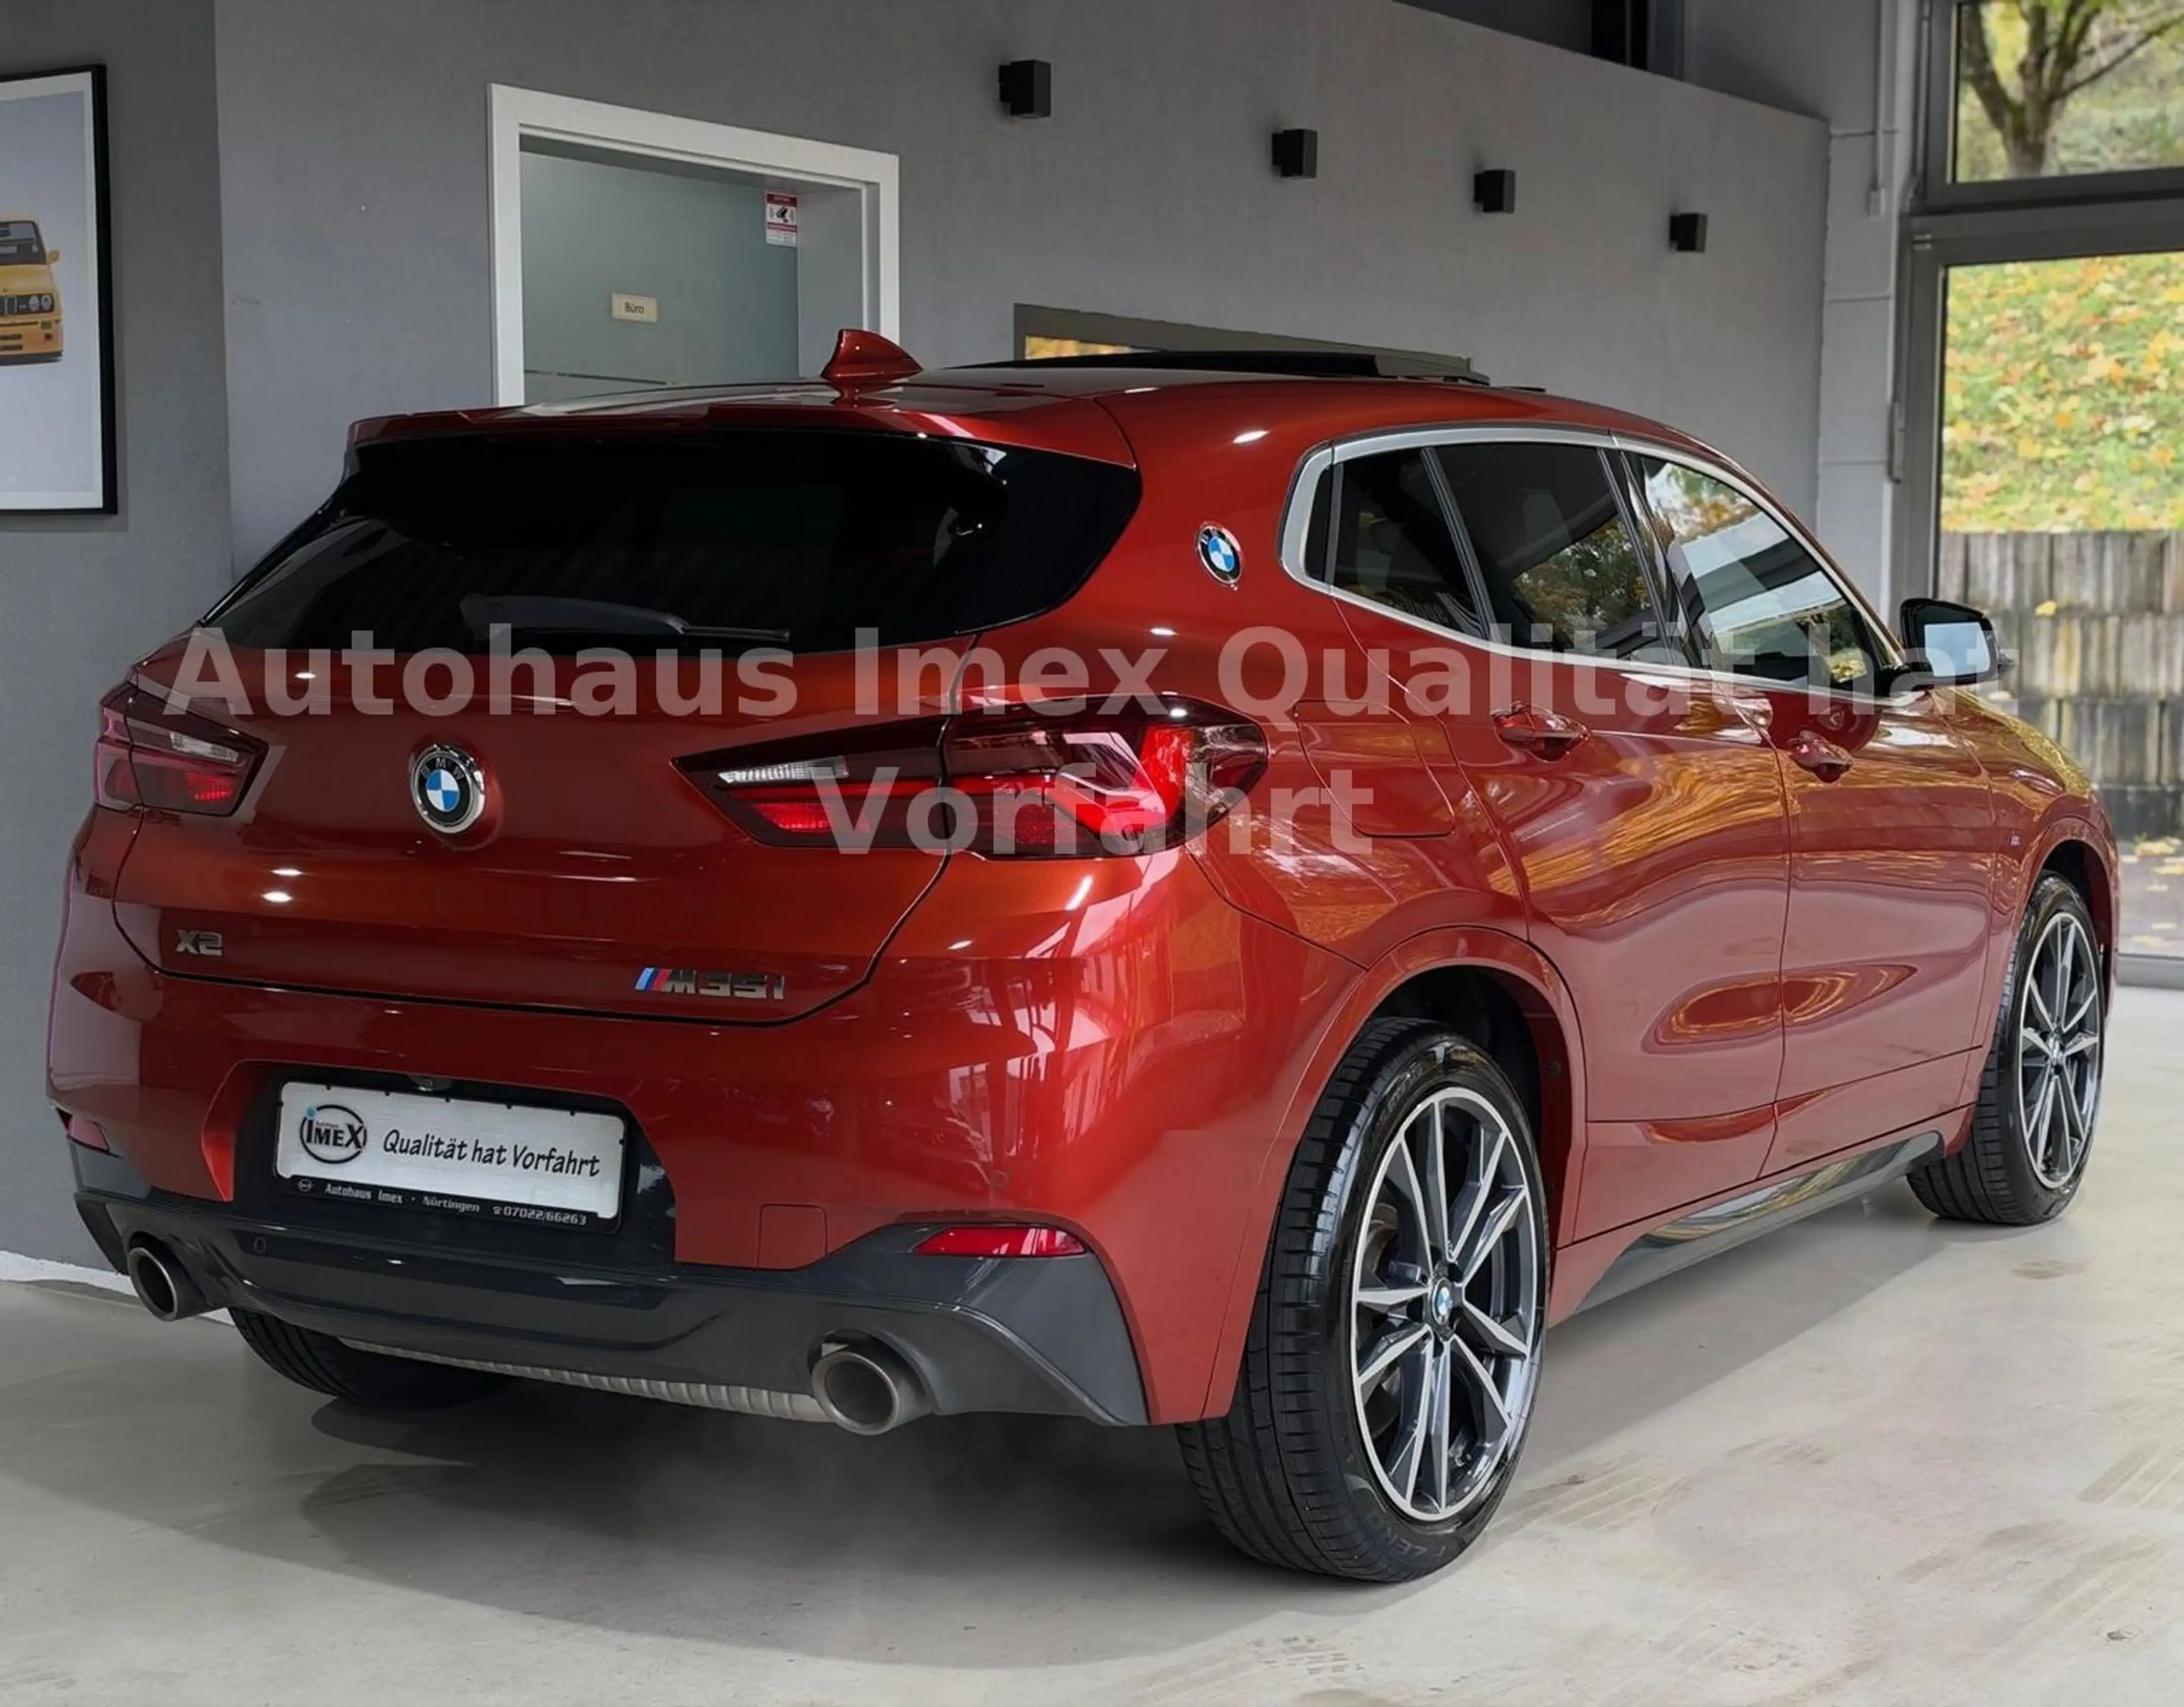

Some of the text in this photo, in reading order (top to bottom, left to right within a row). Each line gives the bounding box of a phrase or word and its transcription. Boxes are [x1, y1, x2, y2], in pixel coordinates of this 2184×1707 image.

[625, 301, 644, 314] Büro
[176, 929, 222, 955] X2
[659, 968, 784, 999] M35i
[383, 1129, 600, 1177] Qualität hat Vorfahrt
[325, 1184, 372, 1200] Autohaus
[378, 1190, 403, 1204] Imex
[423, 1195, 480, 1213] Nürtingen
